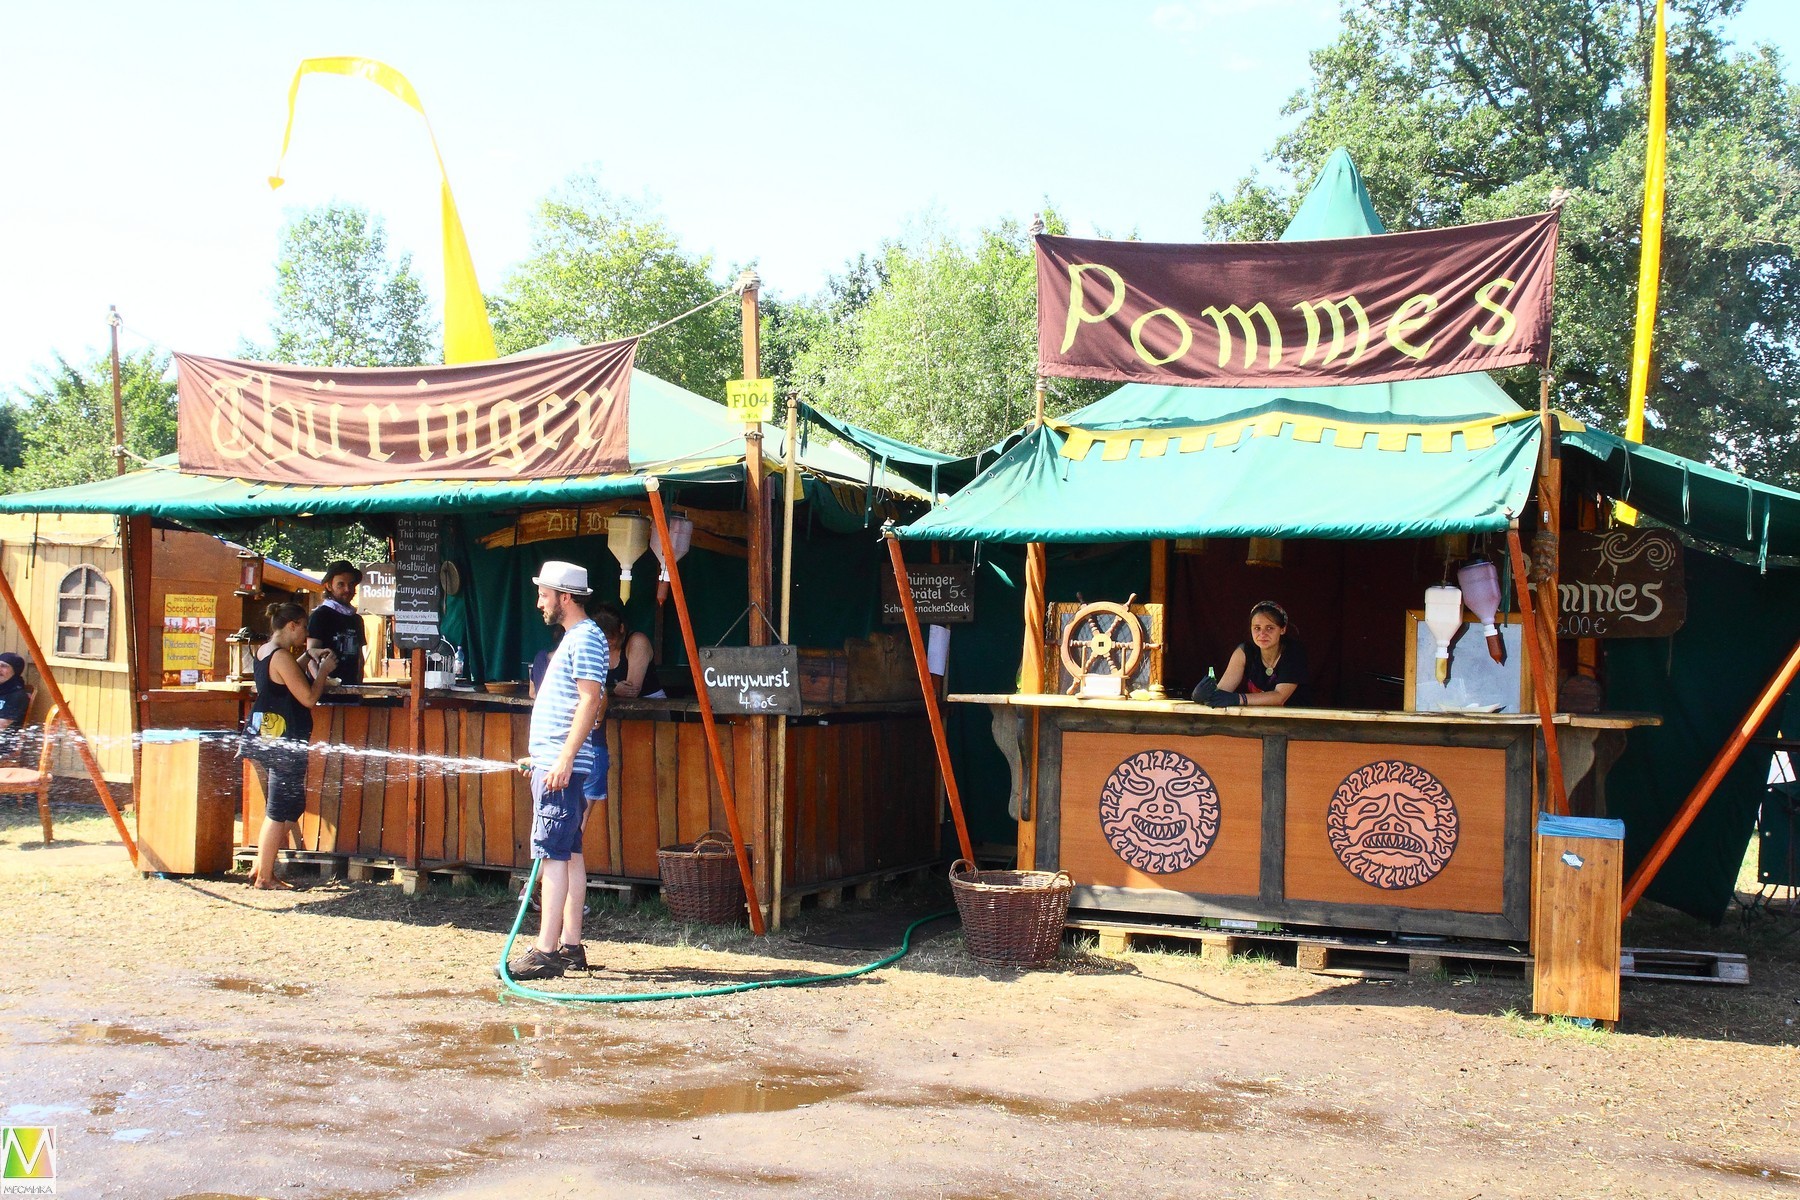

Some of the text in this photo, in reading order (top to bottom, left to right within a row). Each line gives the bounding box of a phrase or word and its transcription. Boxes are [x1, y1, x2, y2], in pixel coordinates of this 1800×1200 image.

[1060, 263, 1517, 370] Pommes
[732, 393, 769, 408] F104
[206, 372, 613, 474] Thüringer
[547, 510, 577, 532] Die
[398, 541, 437, 552] Brawurst
[411, 553, 426, 561] und
[397, 561, 437, 573] Rostbrätel
[906, 571, 955, 588] hüringer
[397, 584, 438, 597] Currywurst
[704, 666, 790, 693] Currywurst
